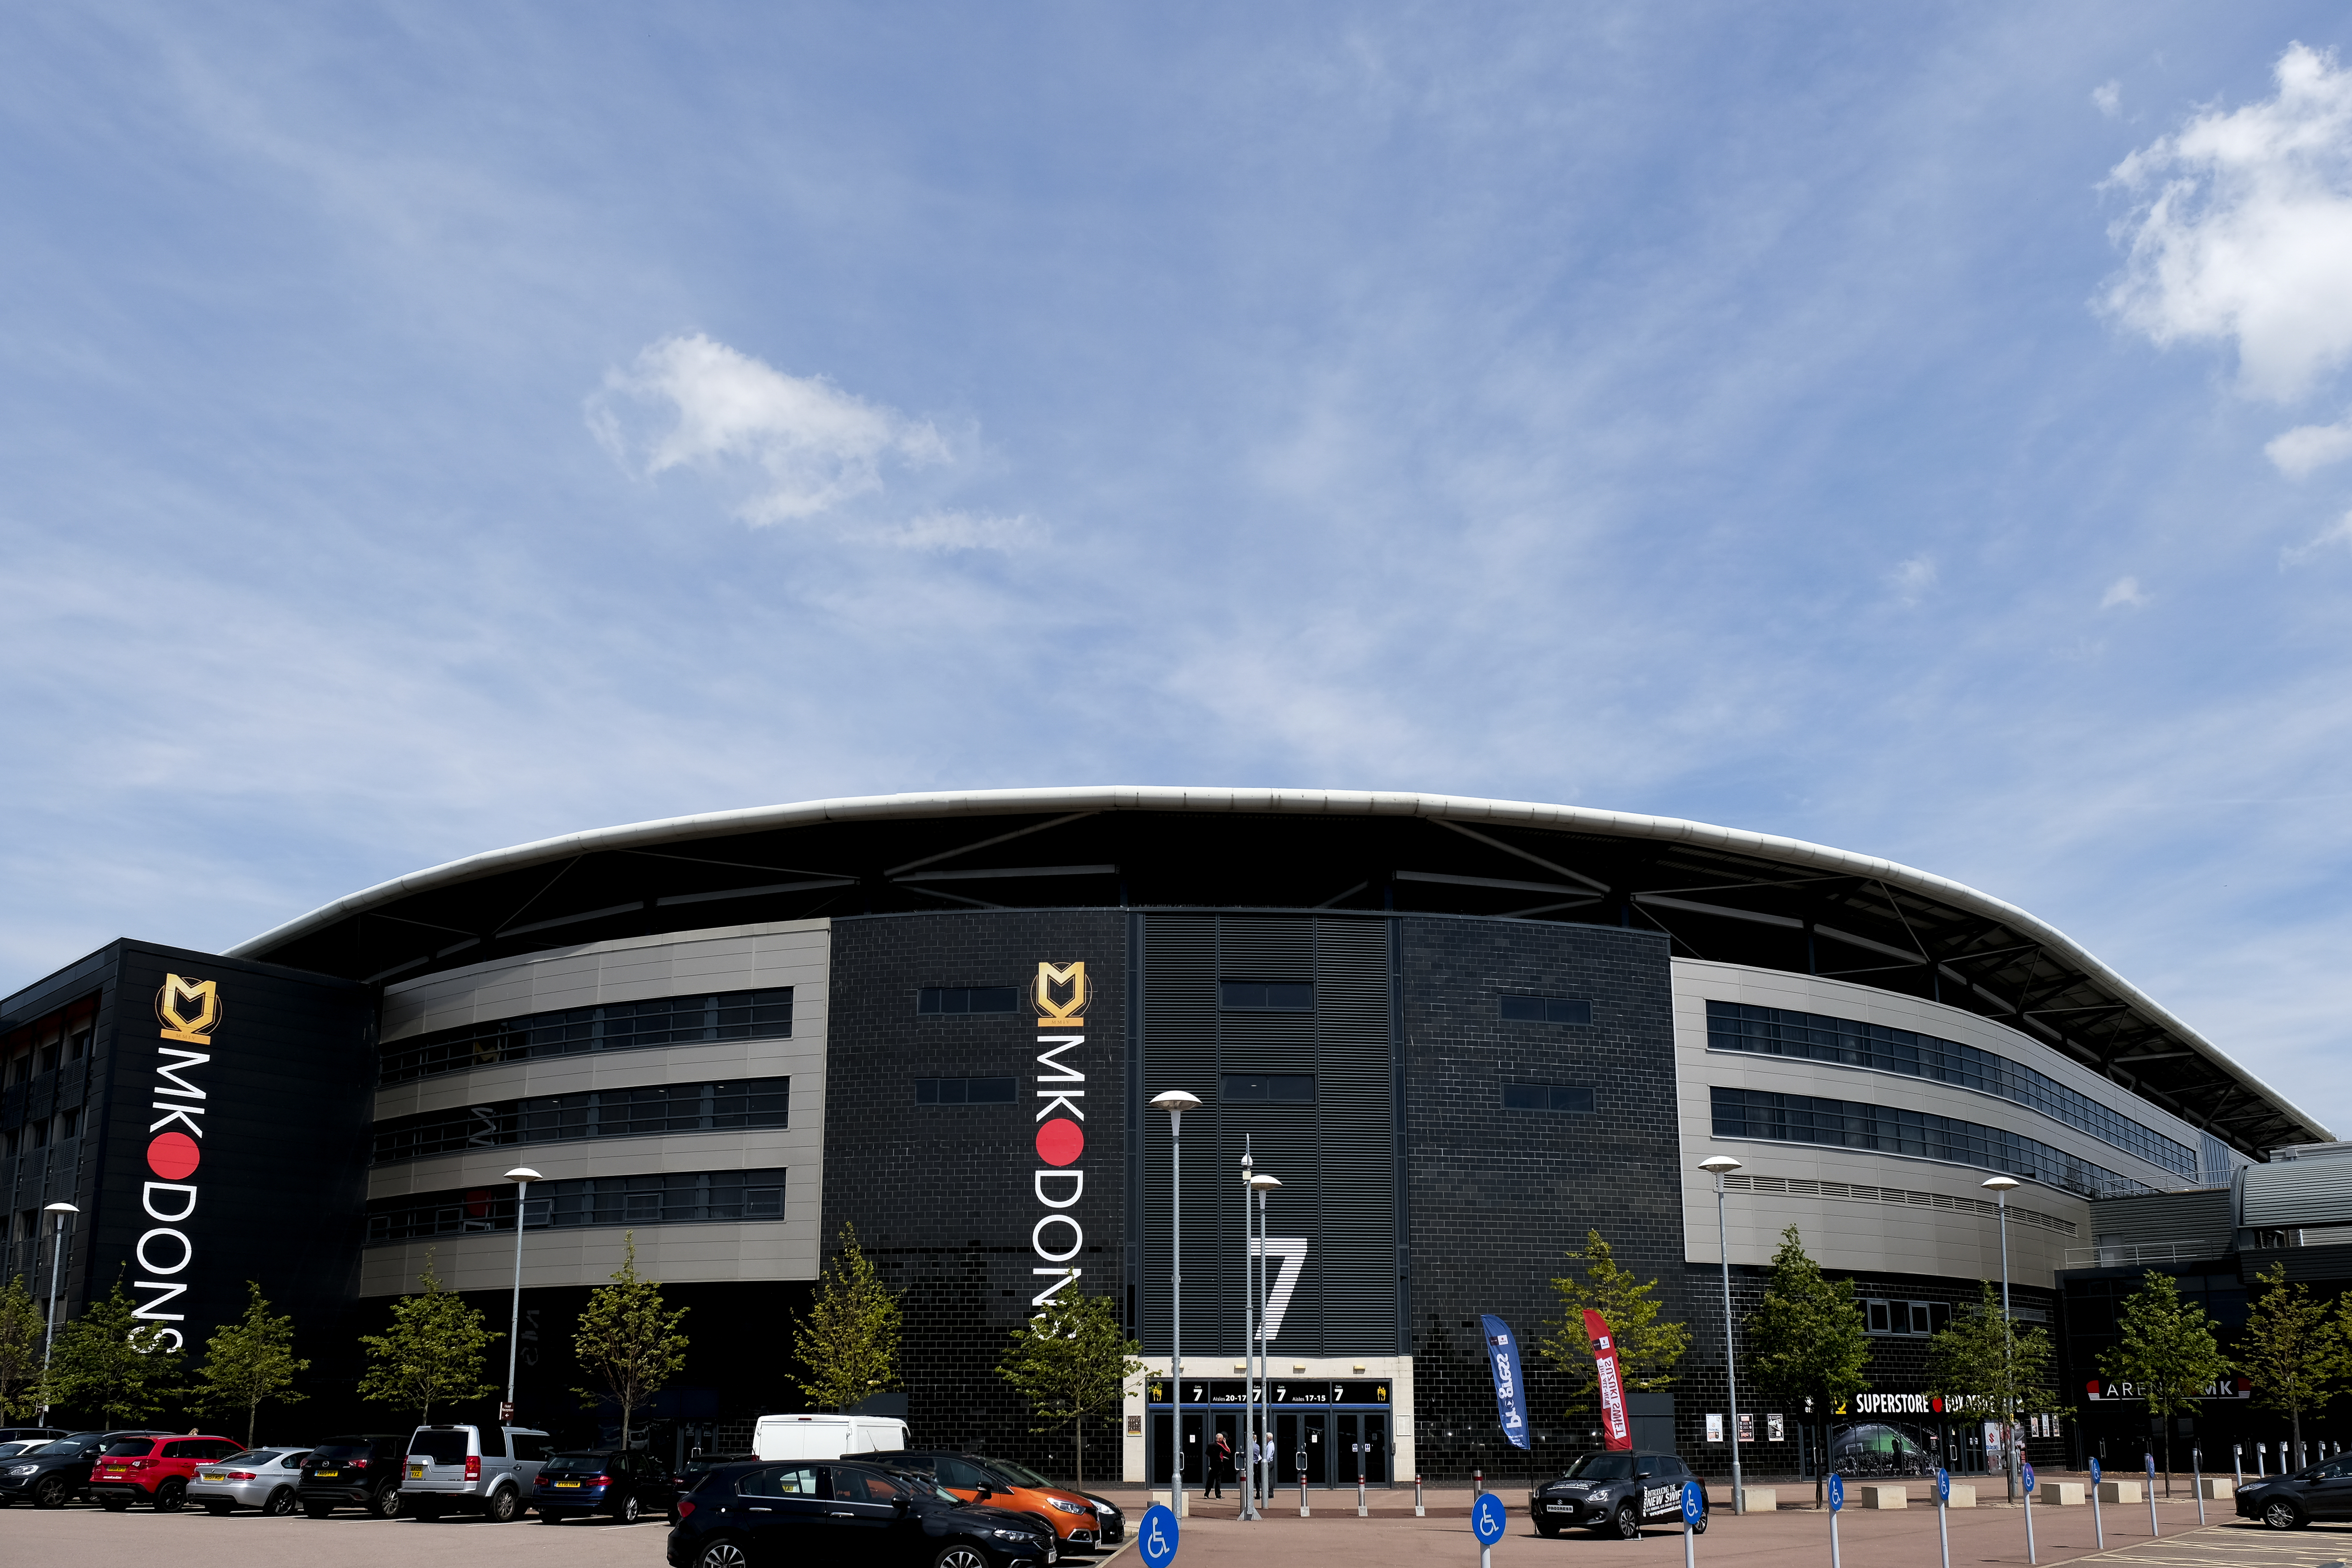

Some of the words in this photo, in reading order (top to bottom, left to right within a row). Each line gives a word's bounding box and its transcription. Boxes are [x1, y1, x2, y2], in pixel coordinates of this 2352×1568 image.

[1036, 1035, 1085, 1122] MK
[150, 1047, 210, 1138] MK
[128, 1182, 197, 1353] DONS
[1250, 1238, 1308, 1340] 7
[1193, 1389, 1202, 1401] 7
[1253, 1389, 1261, 1401] 7
[1277, 1389, 1286, 1401] 7
[1335, 1389, 1343, 1401] 7
[2107, 1381, 2173, 1396] AREN
[1856, 1393, 1929, 1413] SUPERSTORE
[1647, 1495, 1663, 1507] NEW
[1664, 1490, 1682, 1503] SWIF
